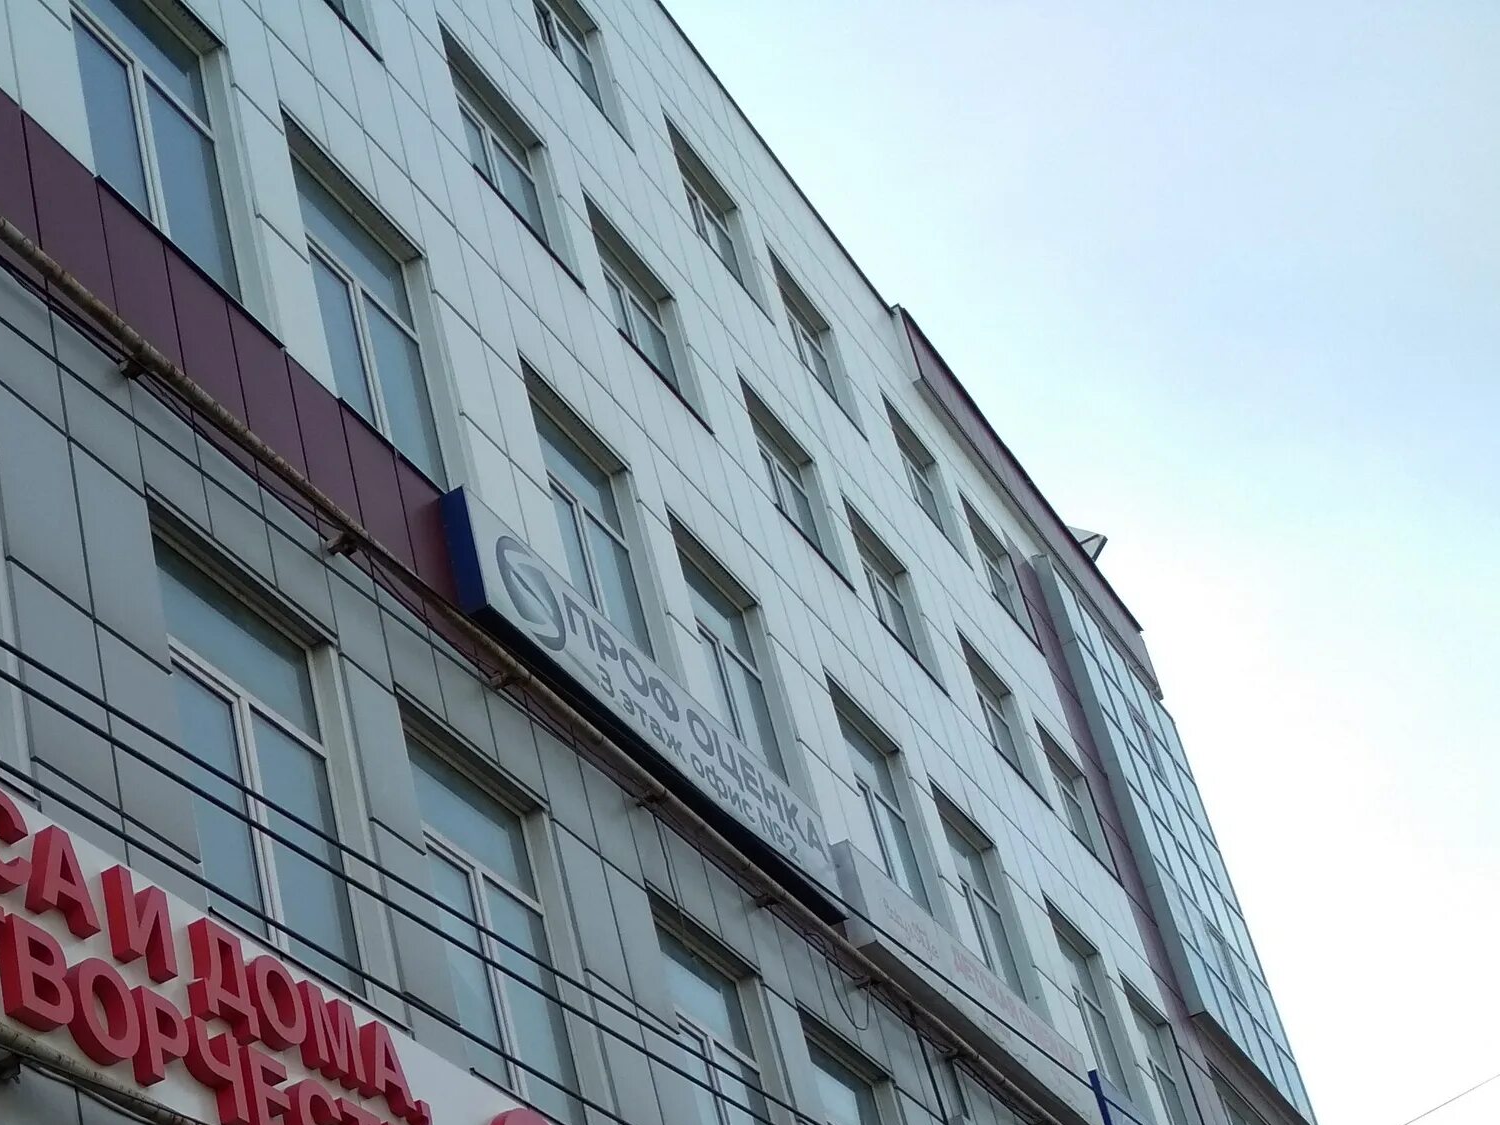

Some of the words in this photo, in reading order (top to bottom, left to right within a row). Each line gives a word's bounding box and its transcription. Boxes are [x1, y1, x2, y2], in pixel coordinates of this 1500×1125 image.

[561, 591, 680, 723] ПРОФ
[686, 707, 829, 863] ОЦЕНКА
[596, 663, 616, 698] 3
[619, 687, 688, 764] этаж
[689, 752, 755, 824] офис
[100, 864, 178, 984] И
